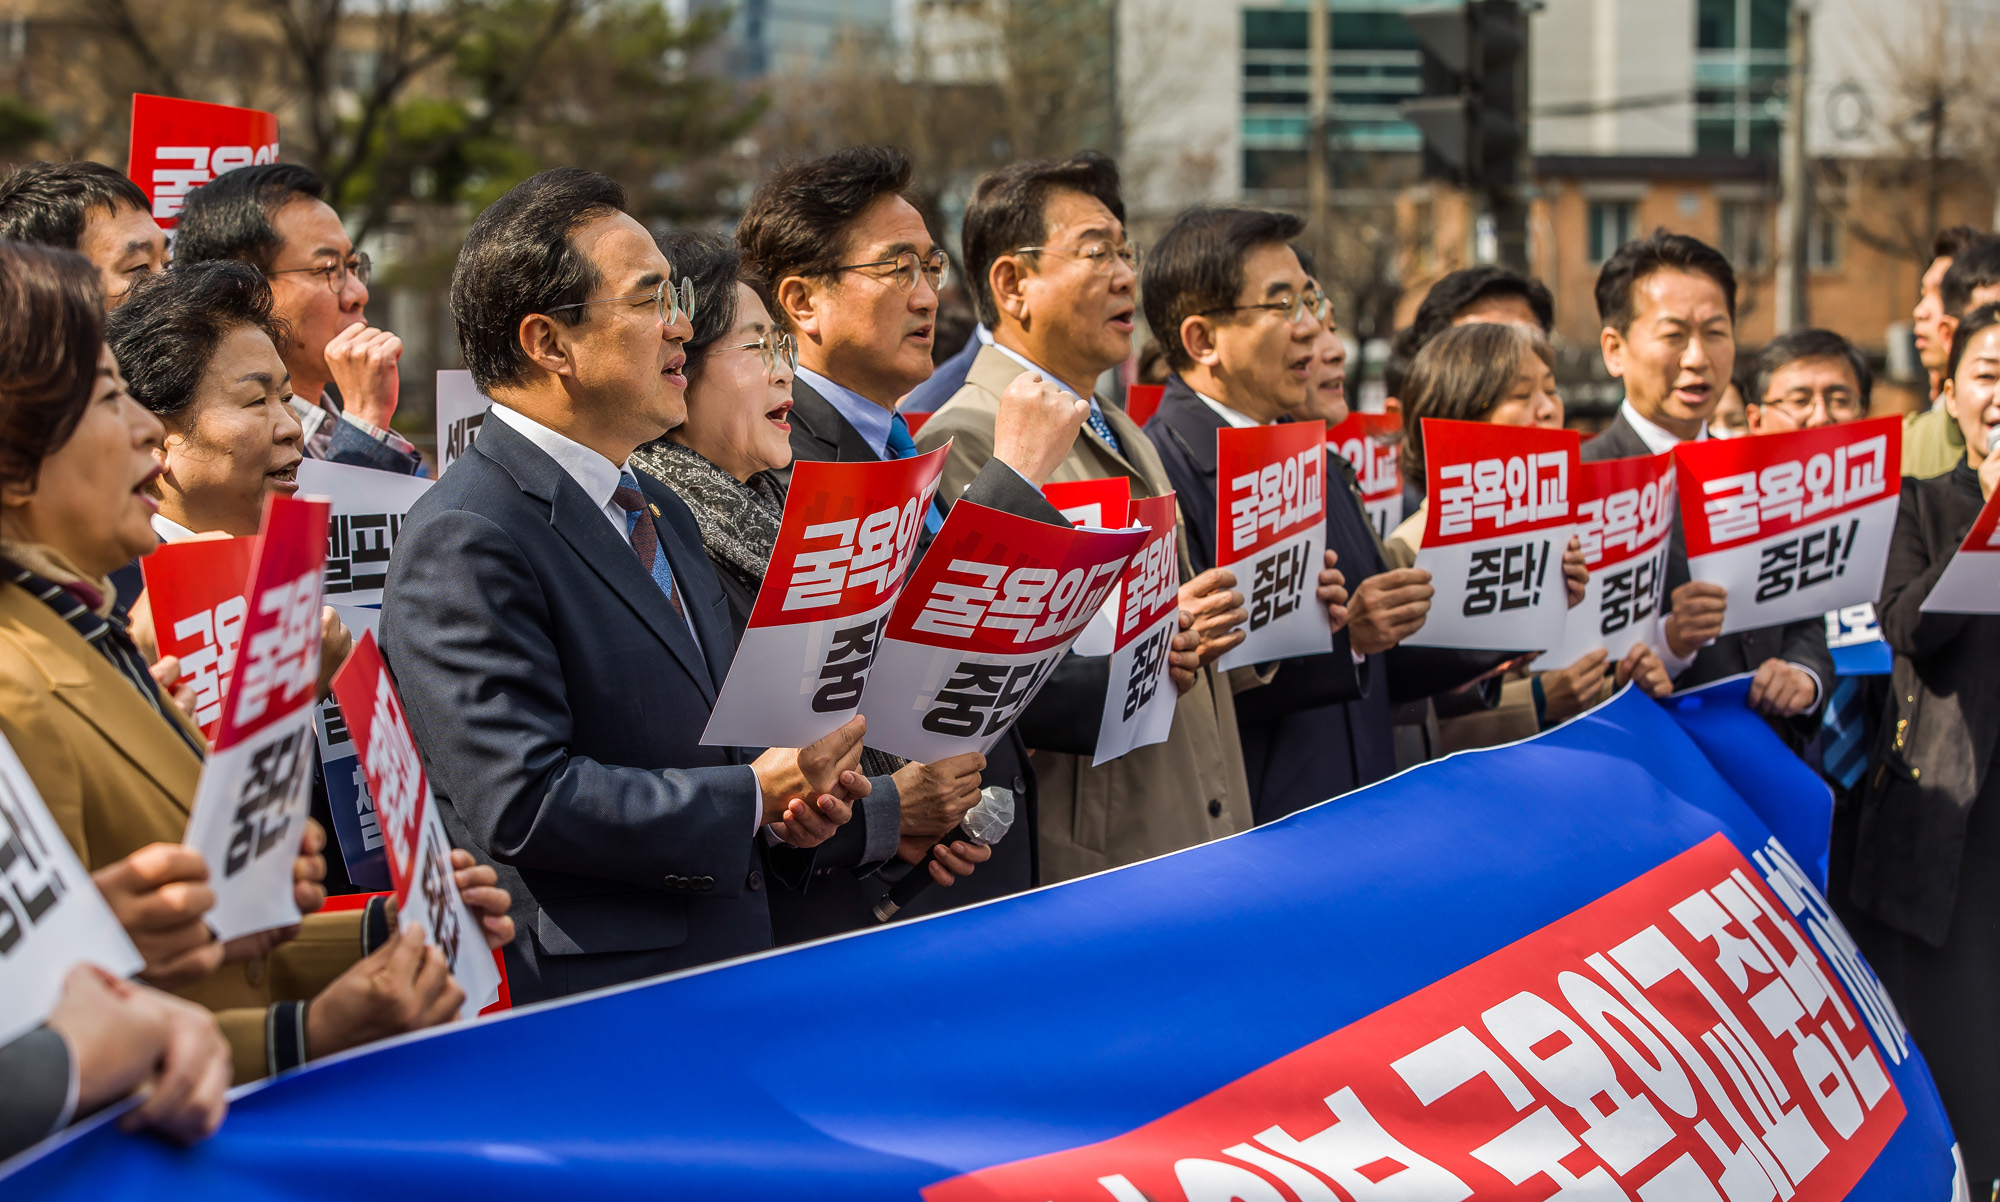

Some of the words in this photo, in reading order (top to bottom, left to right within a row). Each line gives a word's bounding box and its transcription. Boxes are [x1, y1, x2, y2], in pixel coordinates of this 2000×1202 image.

[1231, 444, 1322, 552] 굴욕외교
[1439, 450, 1569, 537] 굴욕외교
[1703, 434, 1887, 545] 굴욕외교
[911, 554, 1129, 645] 굴욕외교
[1250, 540, 1311, 632] 중단!
[1462, 540, 1550, 617] 중단!
[1601, 548, 1665, 638] 중단!
[1755, 518, 1860, 604] 중단!
[1122, 621, 1174, 722] 중단!
